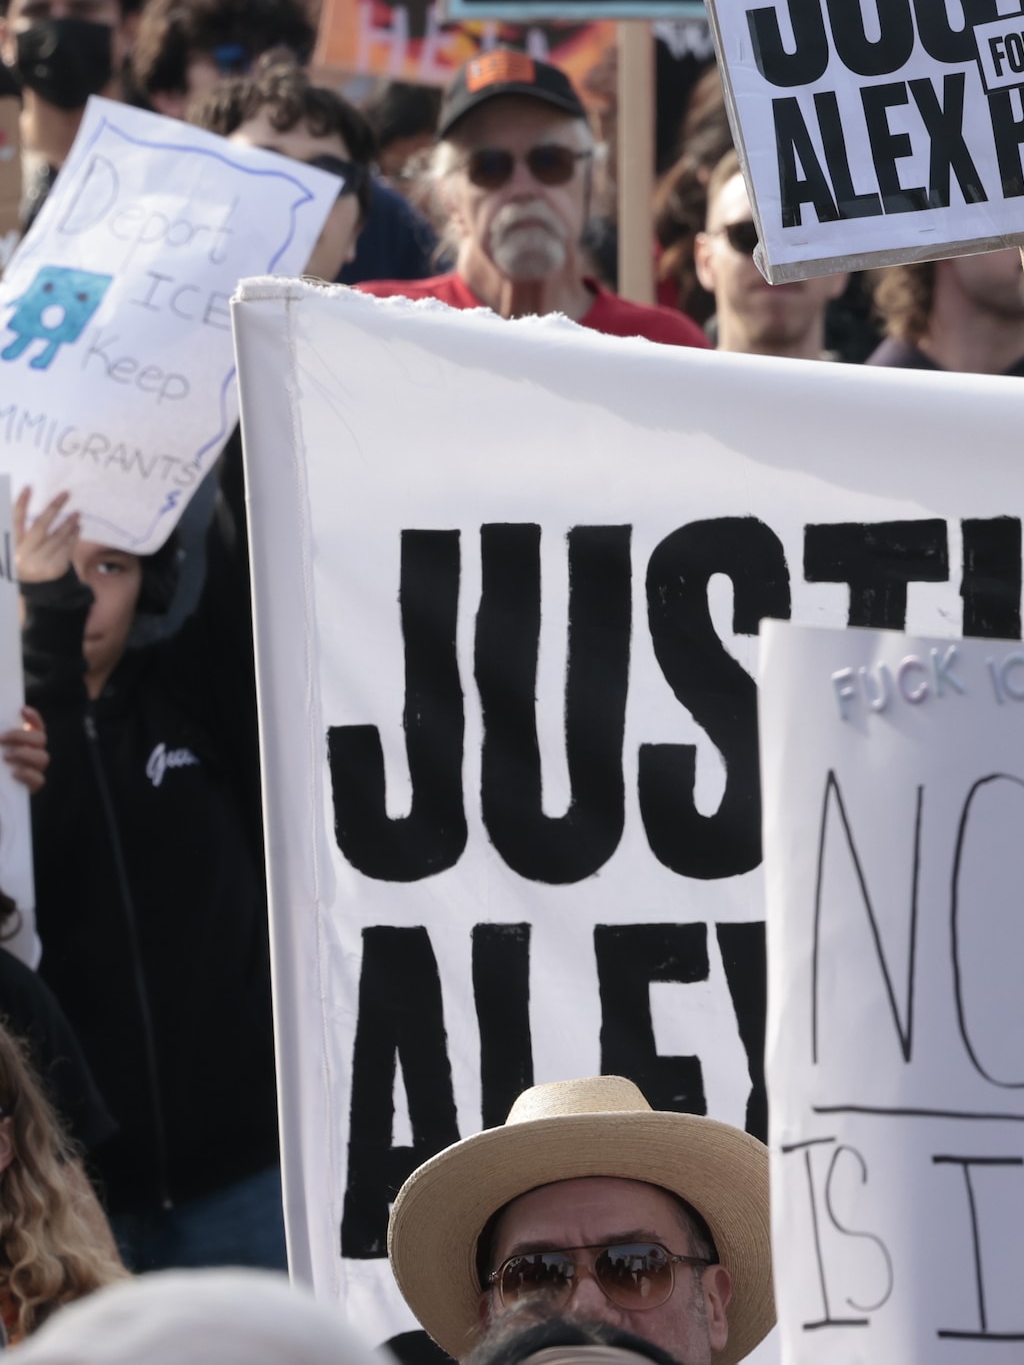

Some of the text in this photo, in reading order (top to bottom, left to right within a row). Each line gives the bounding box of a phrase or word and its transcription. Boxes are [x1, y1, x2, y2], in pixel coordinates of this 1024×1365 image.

[771, 72, 988, 228] ALEX
[57, 153, 240, 275] Deport
[130, 271, 232, 329] ICE
[831, 644, 965, 720] FUCK
[781, 1135, 894, 1330] IS
